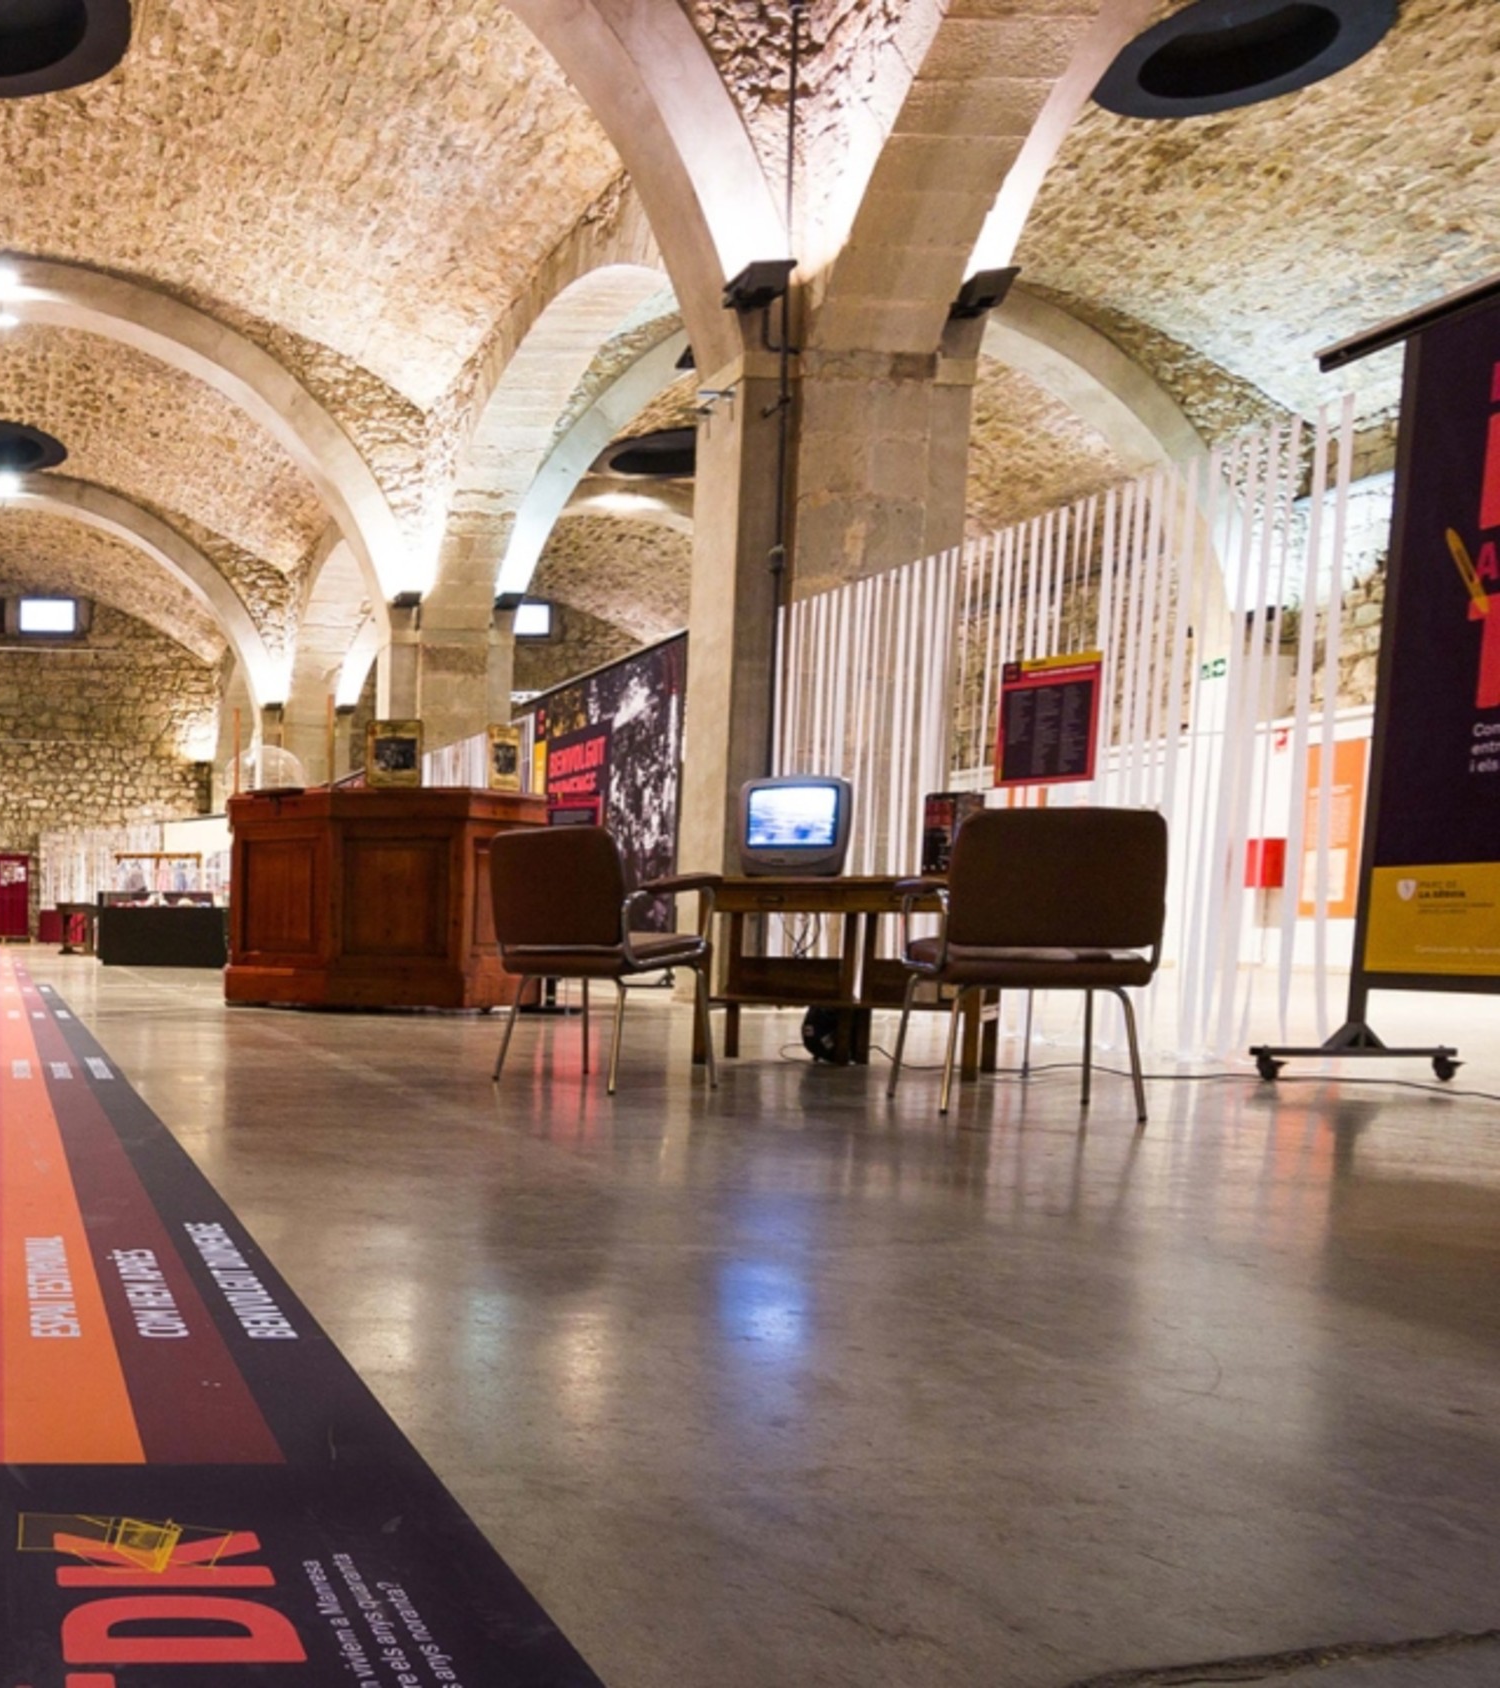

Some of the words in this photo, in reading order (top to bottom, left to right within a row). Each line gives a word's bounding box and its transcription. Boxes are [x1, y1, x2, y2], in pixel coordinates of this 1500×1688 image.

[123, 1283, 177, 1308] HEM
[210, 1270, 299, 1339] BENVOLGUT
[30, 1300, 81, 1338] ESPAI
[132, 1310, 190, 1338] COM
[302, 1560, 346, 1615] Manresa
[332, 1553, 381, 1610] quaranta
[328, 1617, 350, 1627] a
[363, 1611, 394, 1645] anys
[376, 1581, 433, 1642] noranta?
[380, 1647, 412, 1671] els
[418, 1644, 456, 1681] anys
